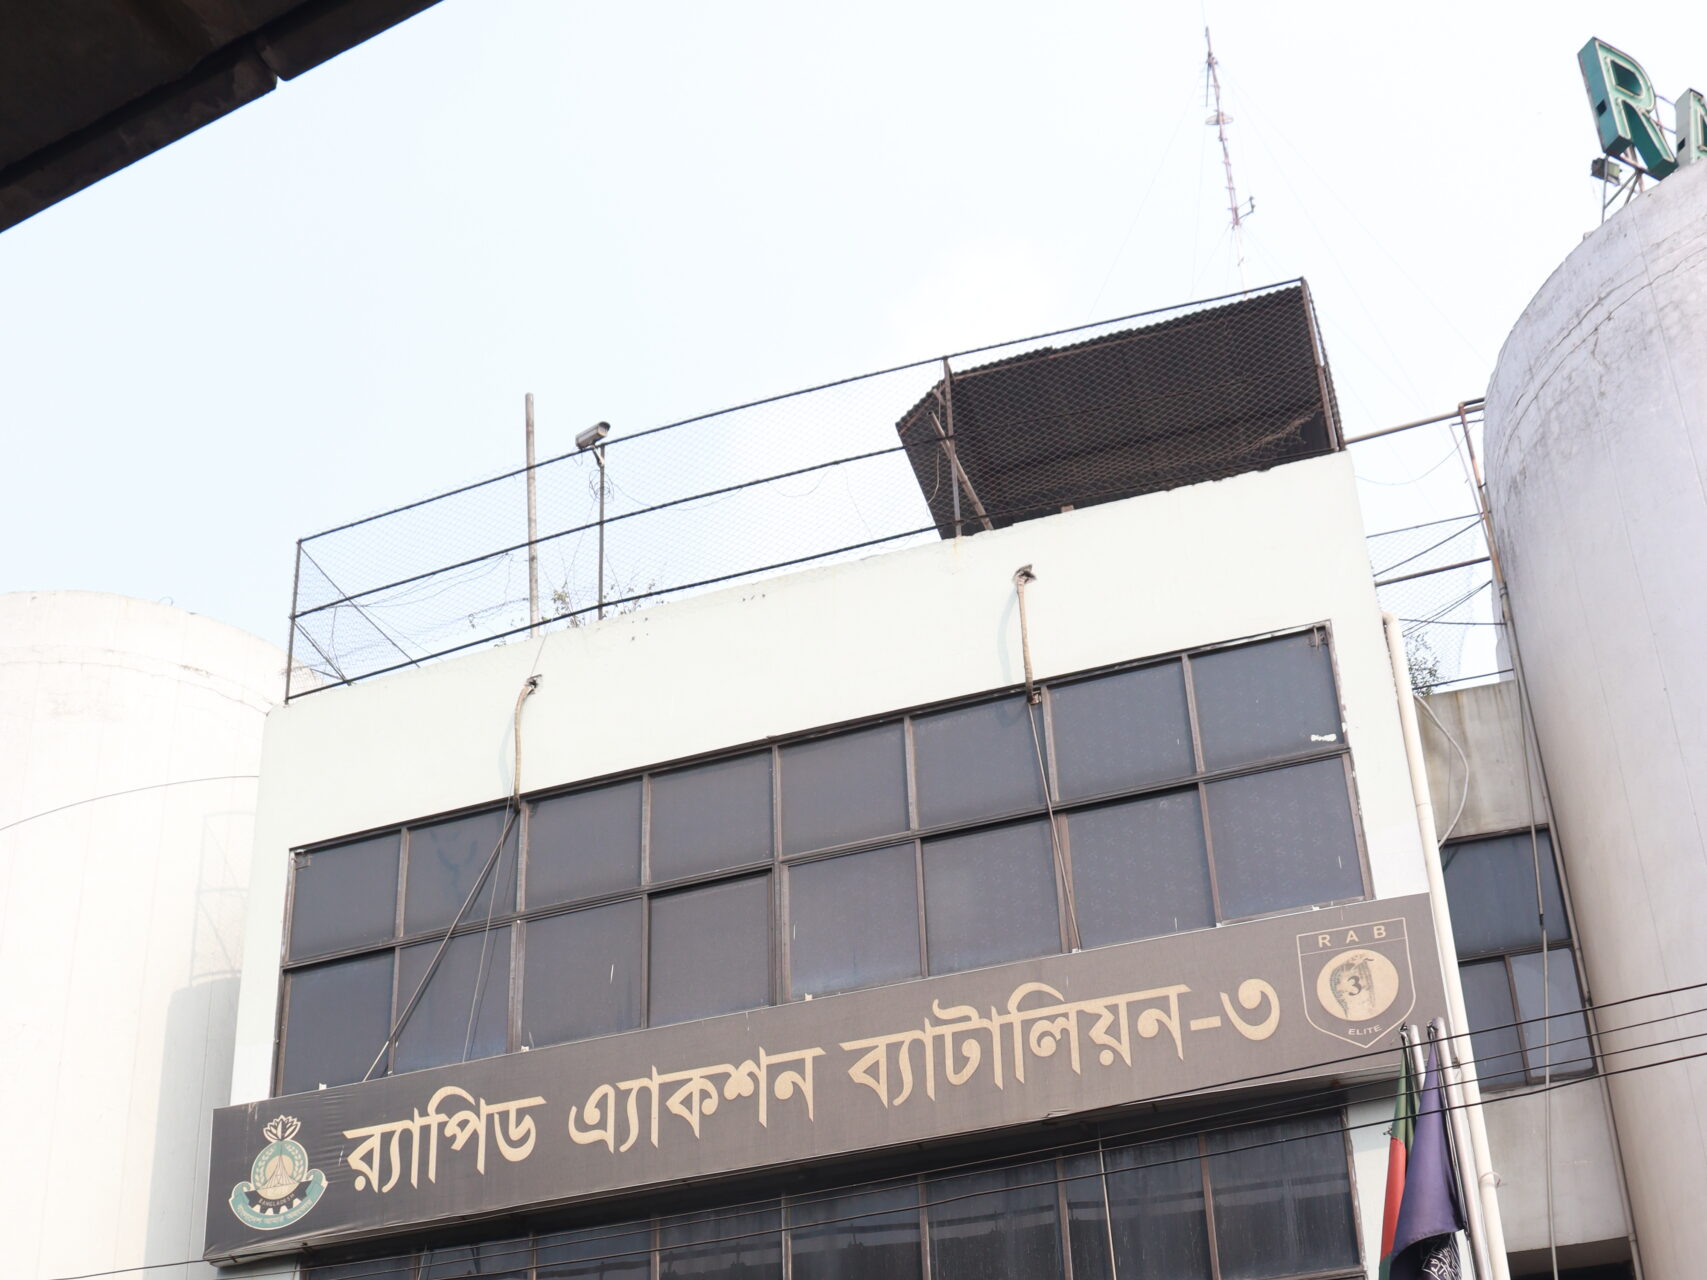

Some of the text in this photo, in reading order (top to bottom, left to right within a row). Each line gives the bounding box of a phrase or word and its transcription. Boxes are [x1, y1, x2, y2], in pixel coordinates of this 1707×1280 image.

[1318, 925, 1386, 948] RAB
[1347, 975, 1362, 996] 3
[1348, 1025, 1381, 1035] ELITE
